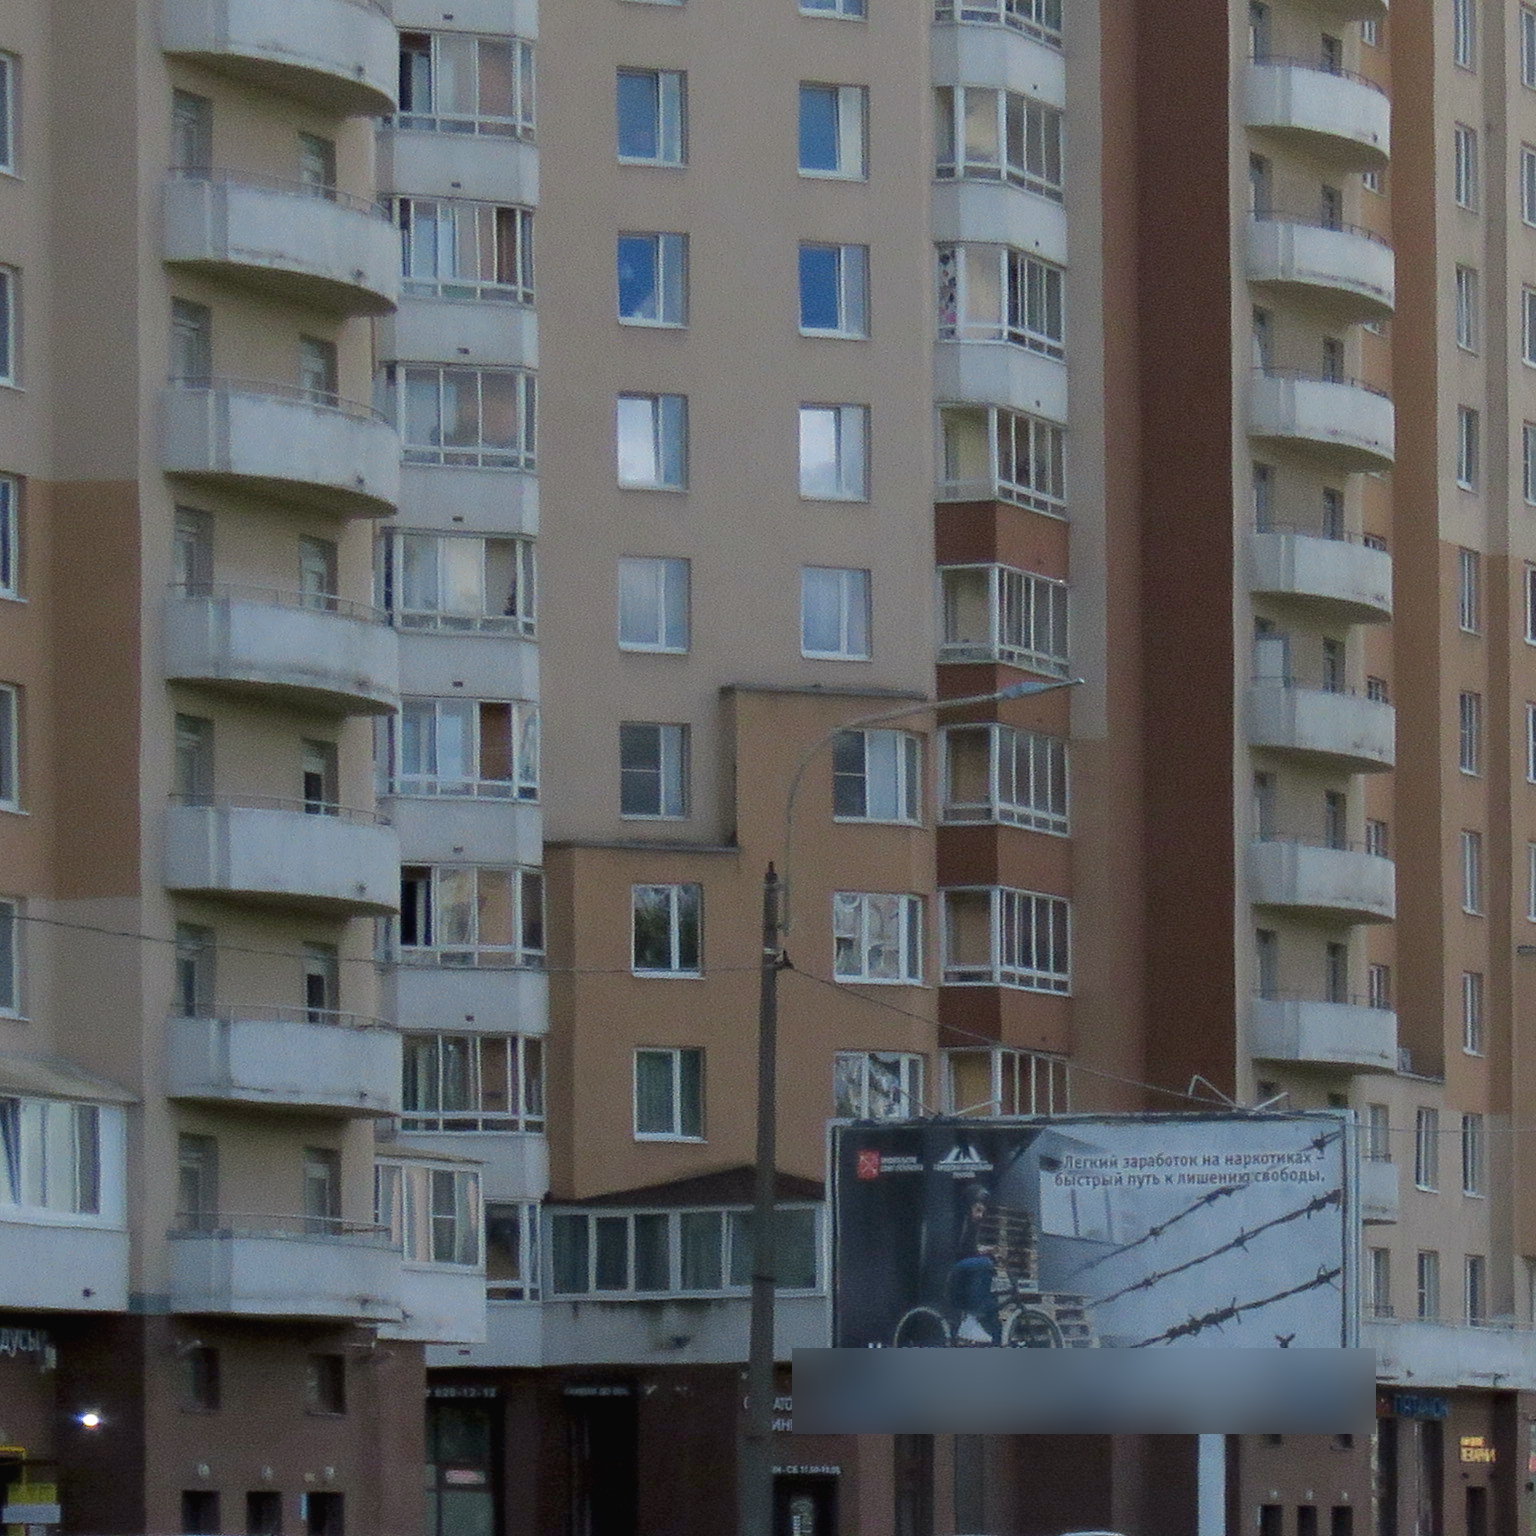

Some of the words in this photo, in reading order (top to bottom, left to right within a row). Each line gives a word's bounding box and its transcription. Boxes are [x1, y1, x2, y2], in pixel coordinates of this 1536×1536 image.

[1063, 1154, 1118, 1169] Легкий
[1123, 1154, 1198, 1170] заработок
[1202, 1155, 1220, 1167] на
[1225, 1154, 1312, 1169] наркотиках
[1055, 1172, 1123, 1189] быстрый
[1127, 1174, 1160, 1190] путь
[1165, 1174, 1174, 1185] к
[1177, 1172, 1250, 1186] лишению
